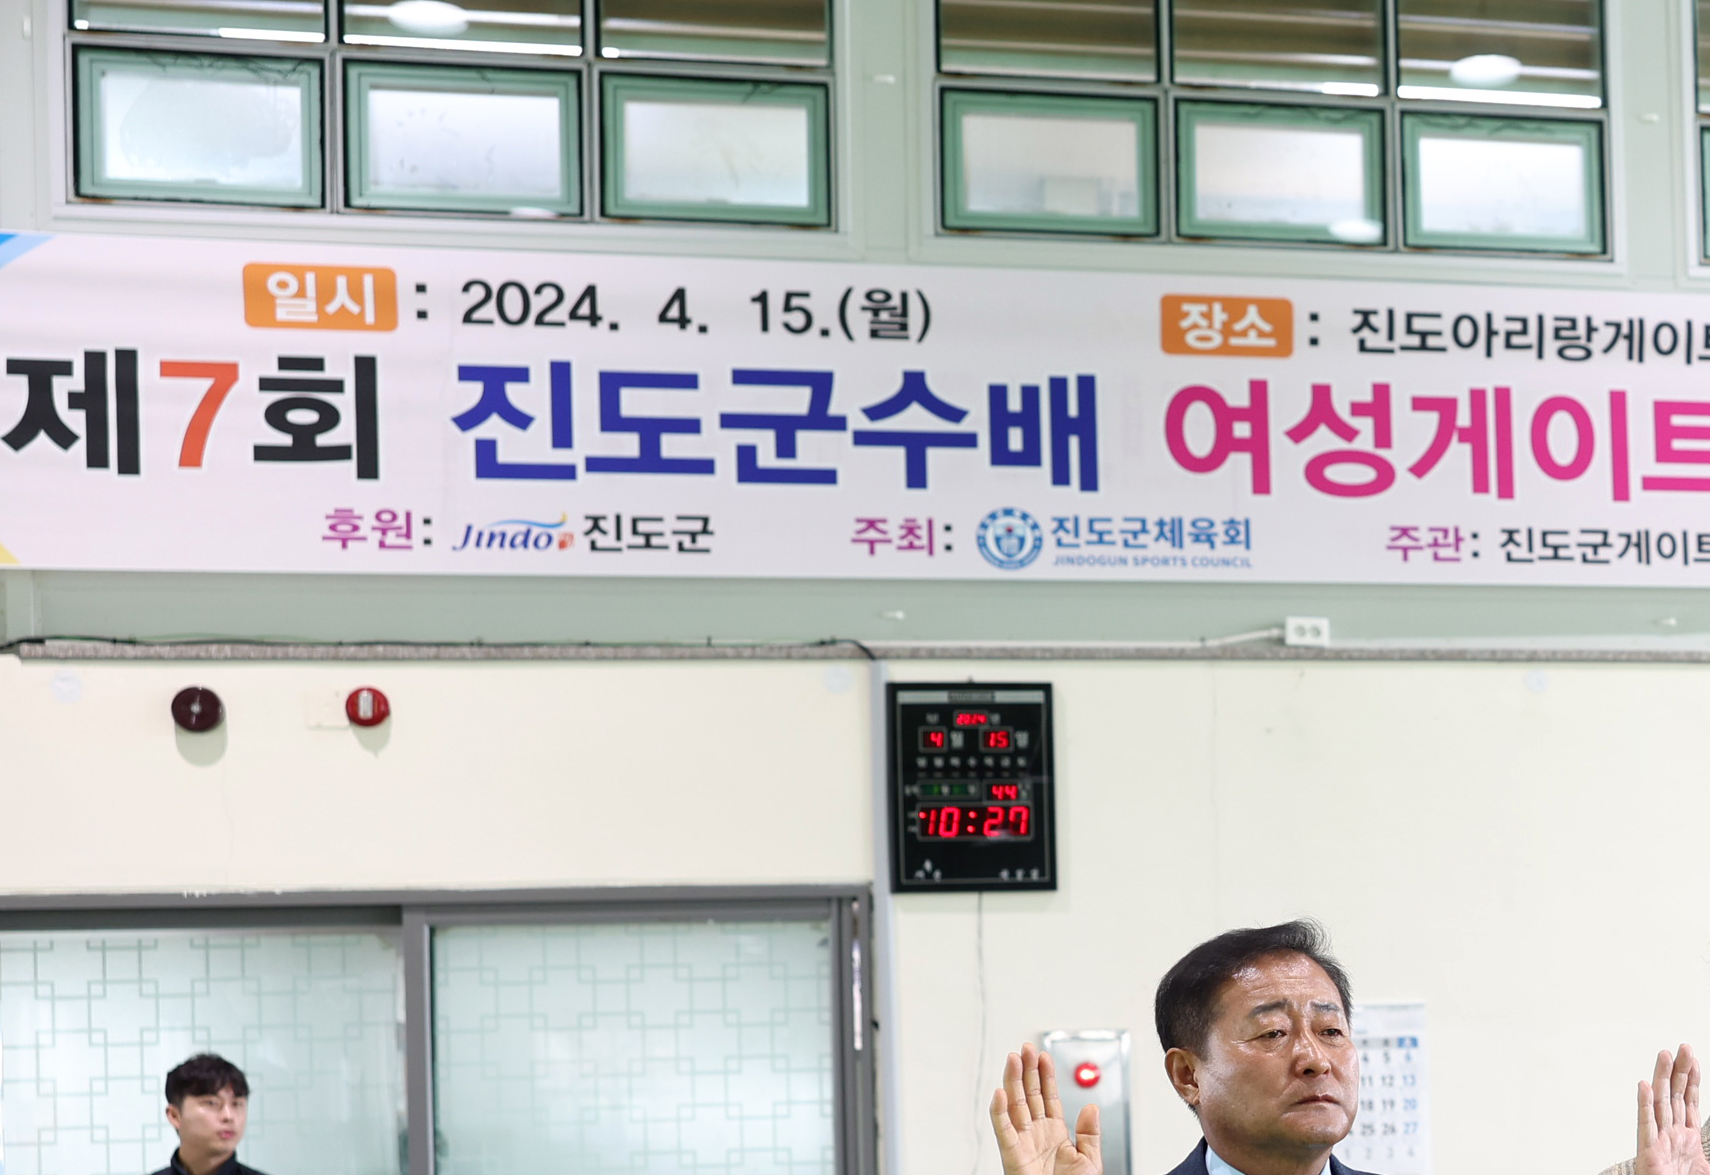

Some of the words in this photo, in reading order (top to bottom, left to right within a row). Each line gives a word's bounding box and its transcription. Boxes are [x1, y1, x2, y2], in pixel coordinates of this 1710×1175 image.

[265, 270, 377, 325] 일시
[461, 279, 620, 332] 2024.
[657, 286, 709, 335] 4.
[1178, 302, 1278, 349] 장소
[2, 347, 381, 481] 제7회
[450, 359, 1100, 494] 진도군수배
[452, 523, 554, 551] Jindo
[583, 513, 715, 554] 진도군
[1051, 515, 1252, 551] 진도군체육회
[1052, 555, 1127, 567] JINDOGUN
[1132, 556, 1187, 568] SPORTS
[1191, 556, 1253, 569] COUNCIL
[929, 731, 945, 748] 4
[989, 731, 1009, 748] 15
[991, 784, 1019, 800] 44
[928, 805, 1031, 838] 10:27
